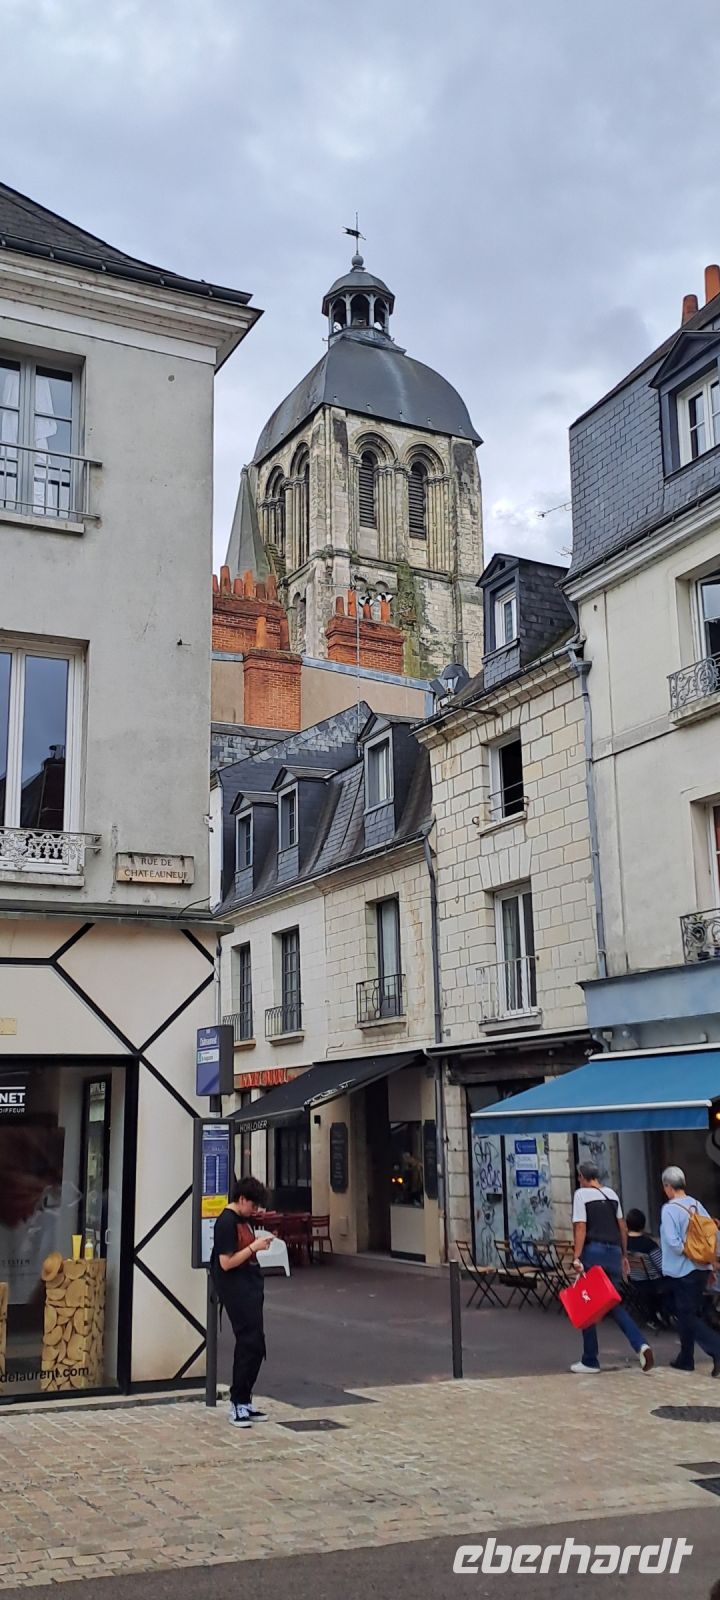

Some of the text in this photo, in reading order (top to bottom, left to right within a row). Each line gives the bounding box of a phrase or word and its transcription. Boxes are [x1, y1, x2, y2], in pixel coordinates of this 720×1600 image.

[141, 858, 172, 867] RUE DE
[124, 869, 188, 879] CHATEAUNEUF
